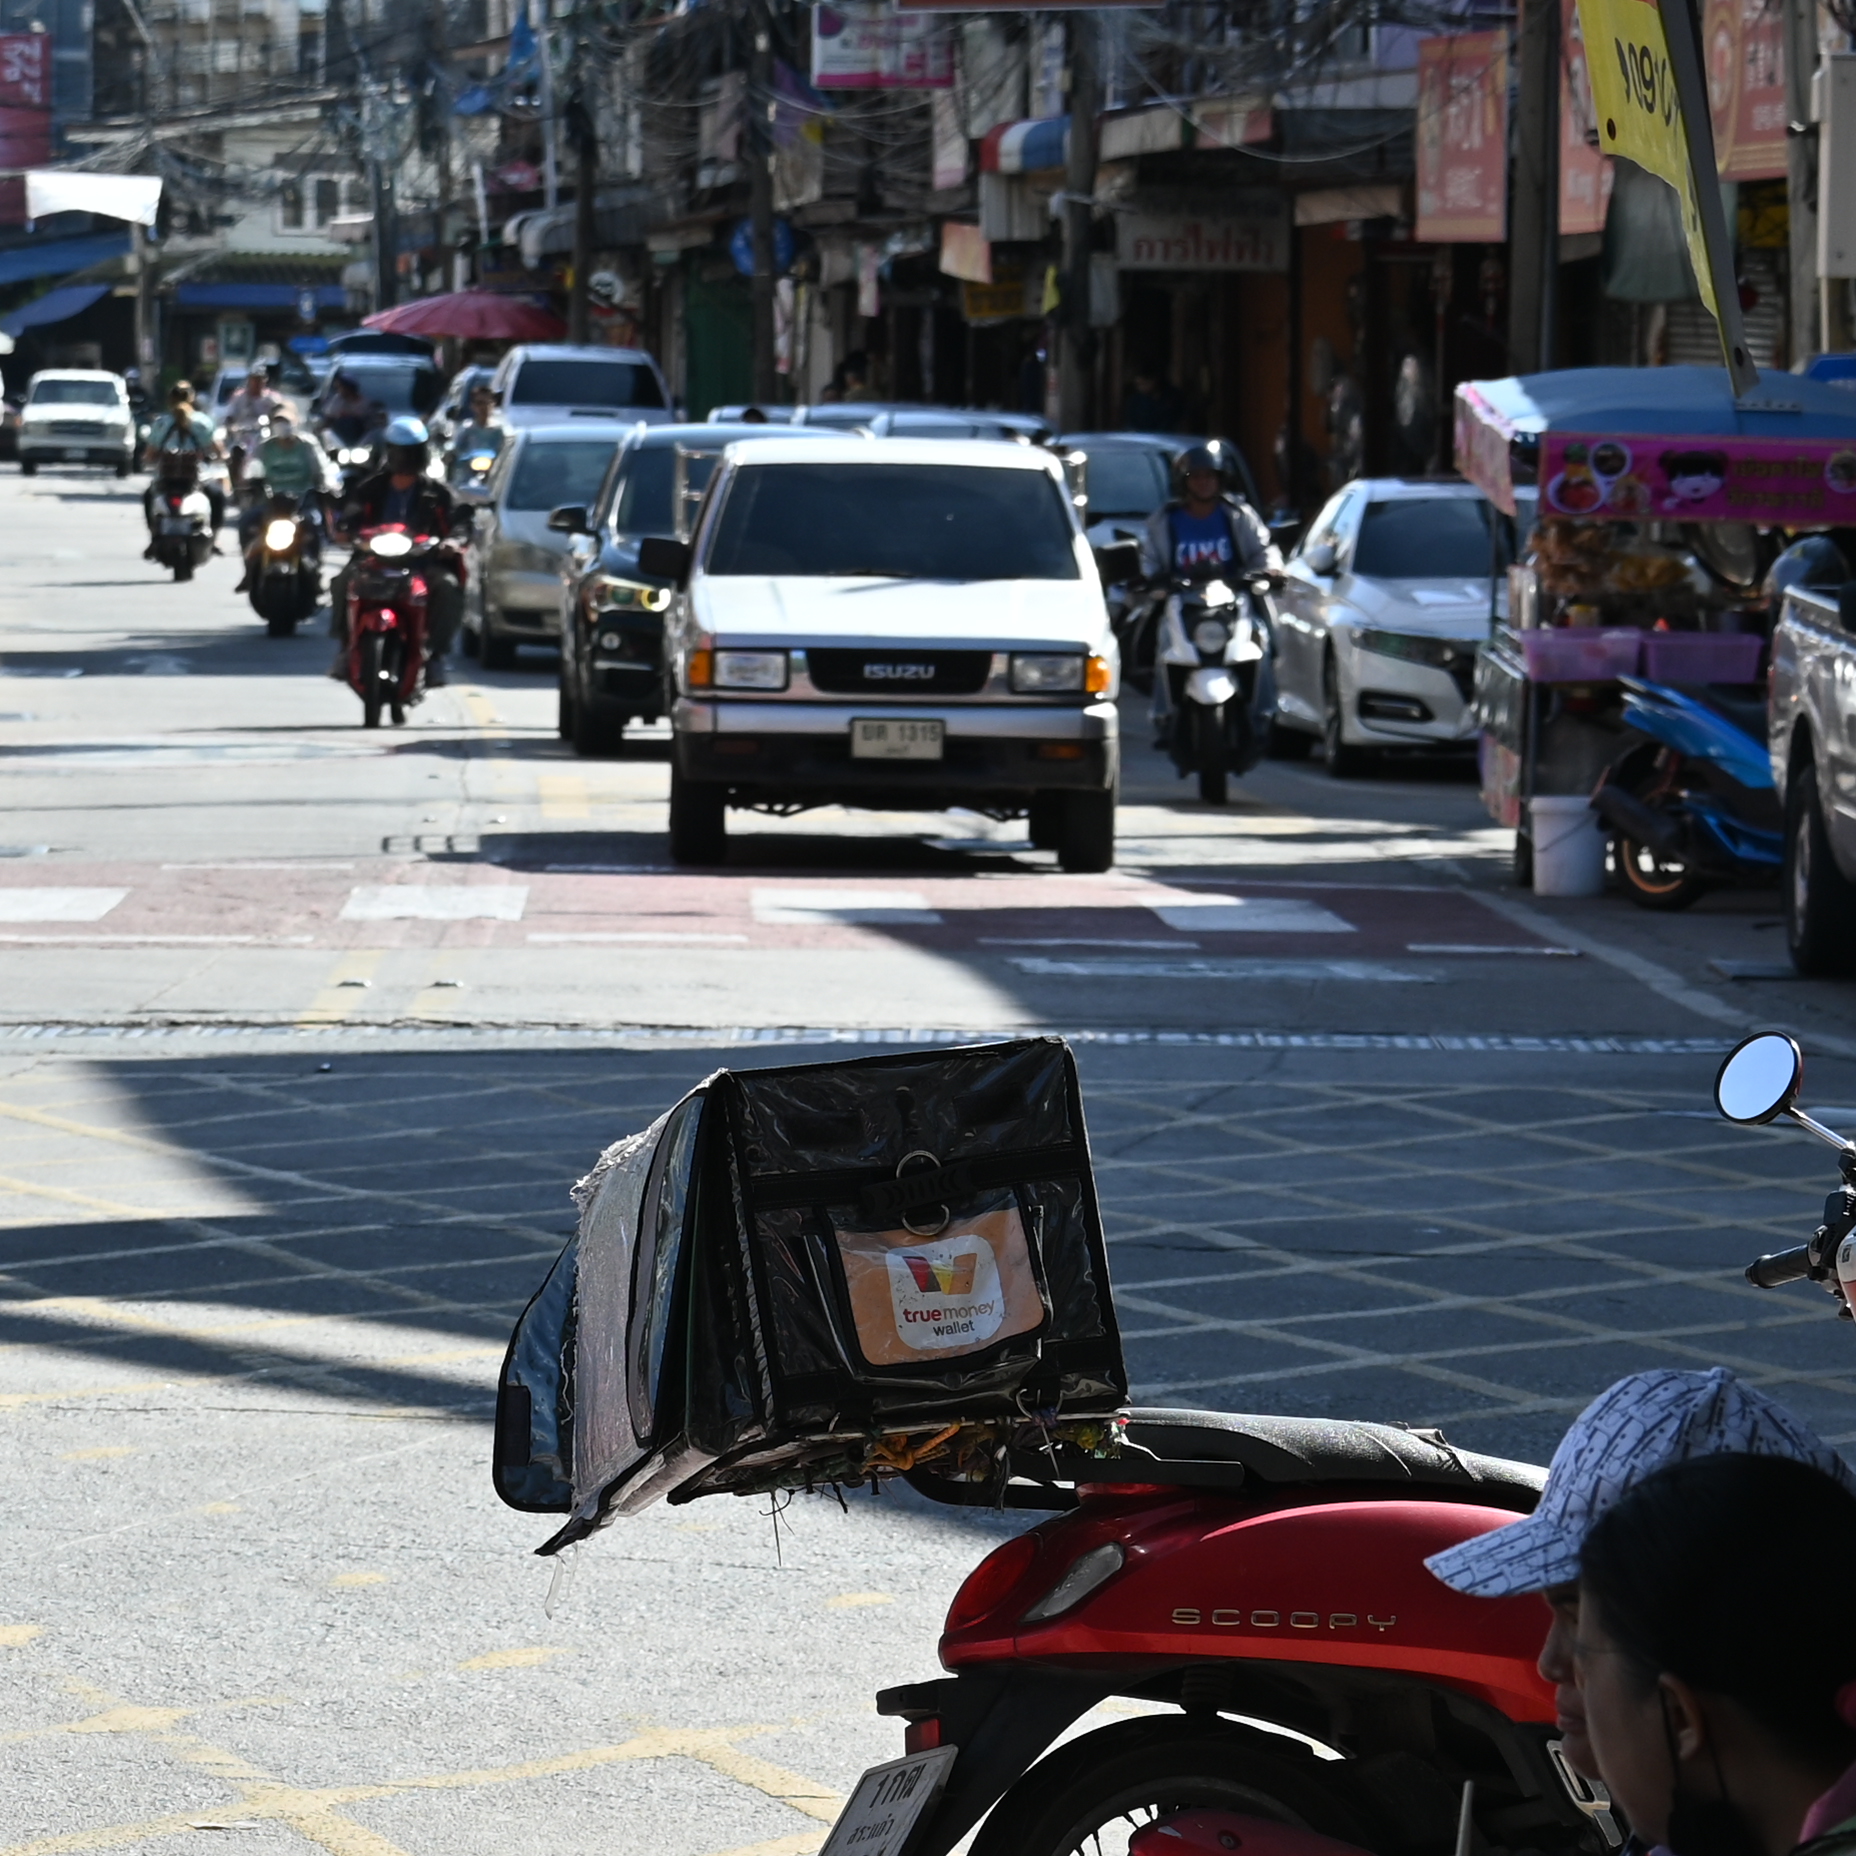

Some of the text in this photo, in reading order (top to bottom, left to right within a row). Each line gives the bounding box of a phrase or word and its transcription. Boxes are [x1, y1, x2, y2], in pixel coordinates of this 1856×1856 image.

[862, 662, 936, 680] ISUZU
[932, 1319, 976, 1338] wallet
[1170, 1606, 1397, 1632] SCOOPY
